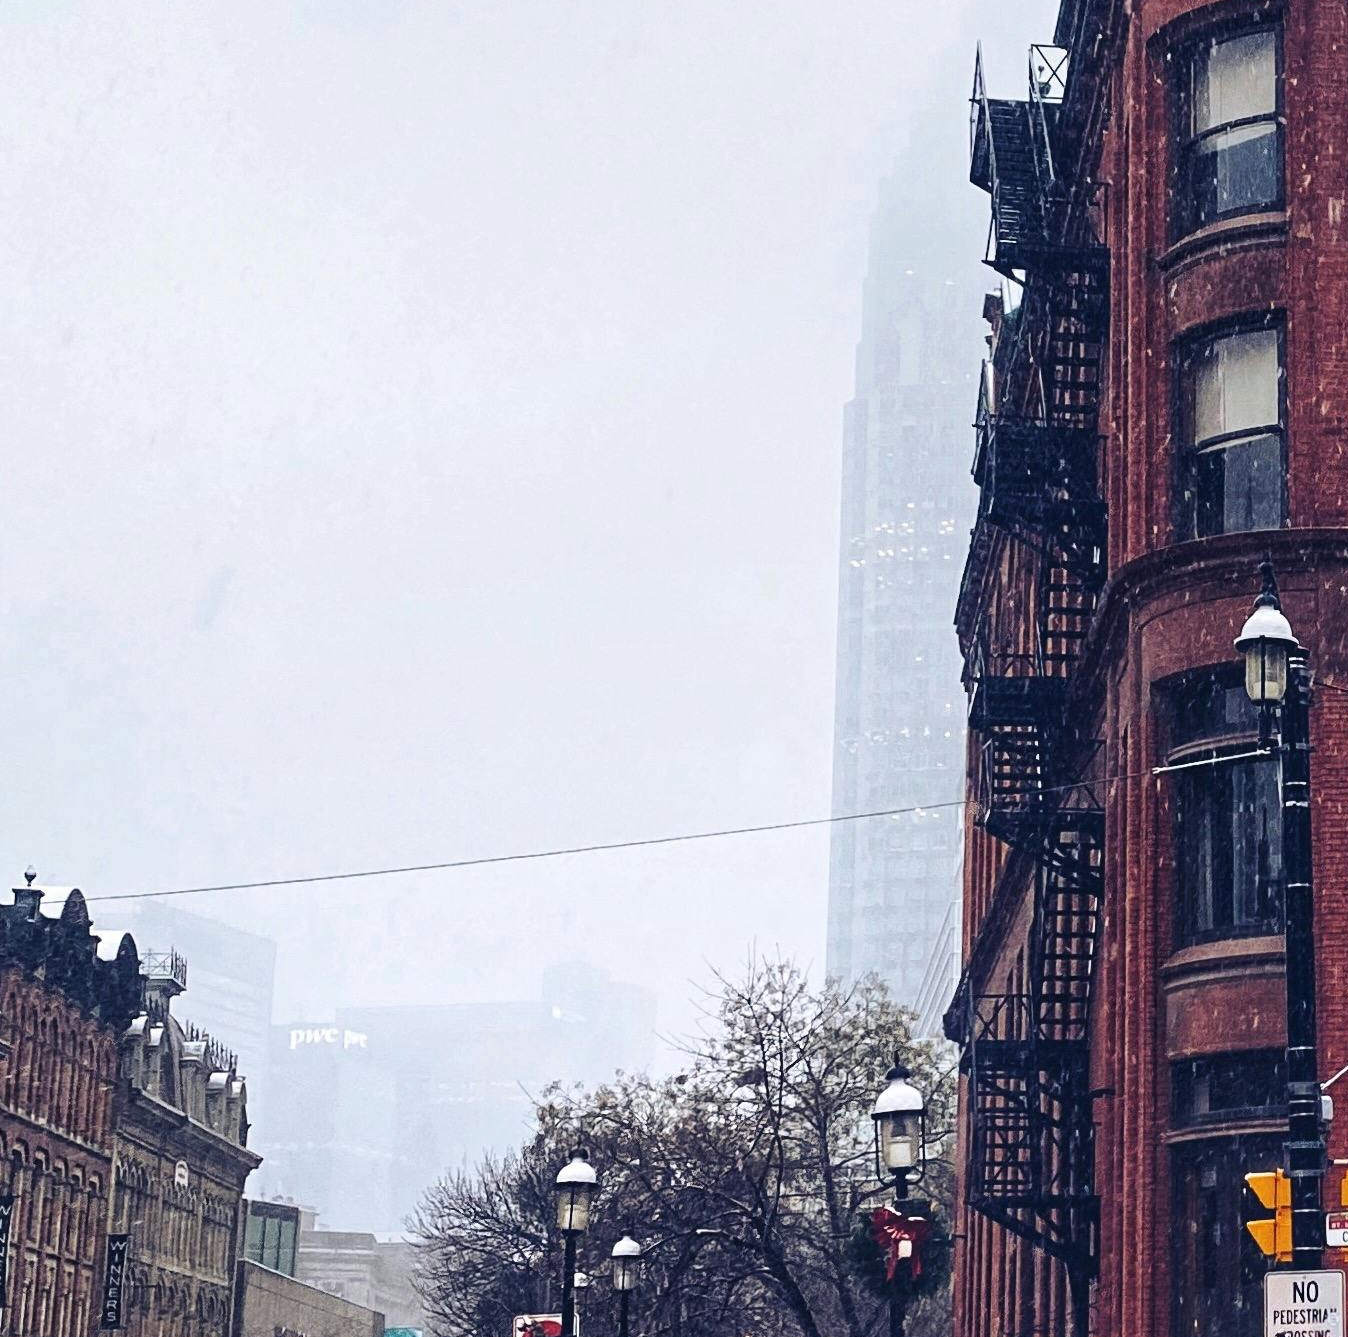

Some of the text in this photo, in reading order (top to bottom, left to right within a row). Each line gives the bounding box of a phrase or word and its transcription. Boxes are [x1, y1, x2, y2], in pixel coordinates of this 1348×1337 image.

[289, 1028, 338, 1050] pwc
[106, 1241, 127, 1322] WINNERS
[1292, 1280, 1319, 1303] NO
